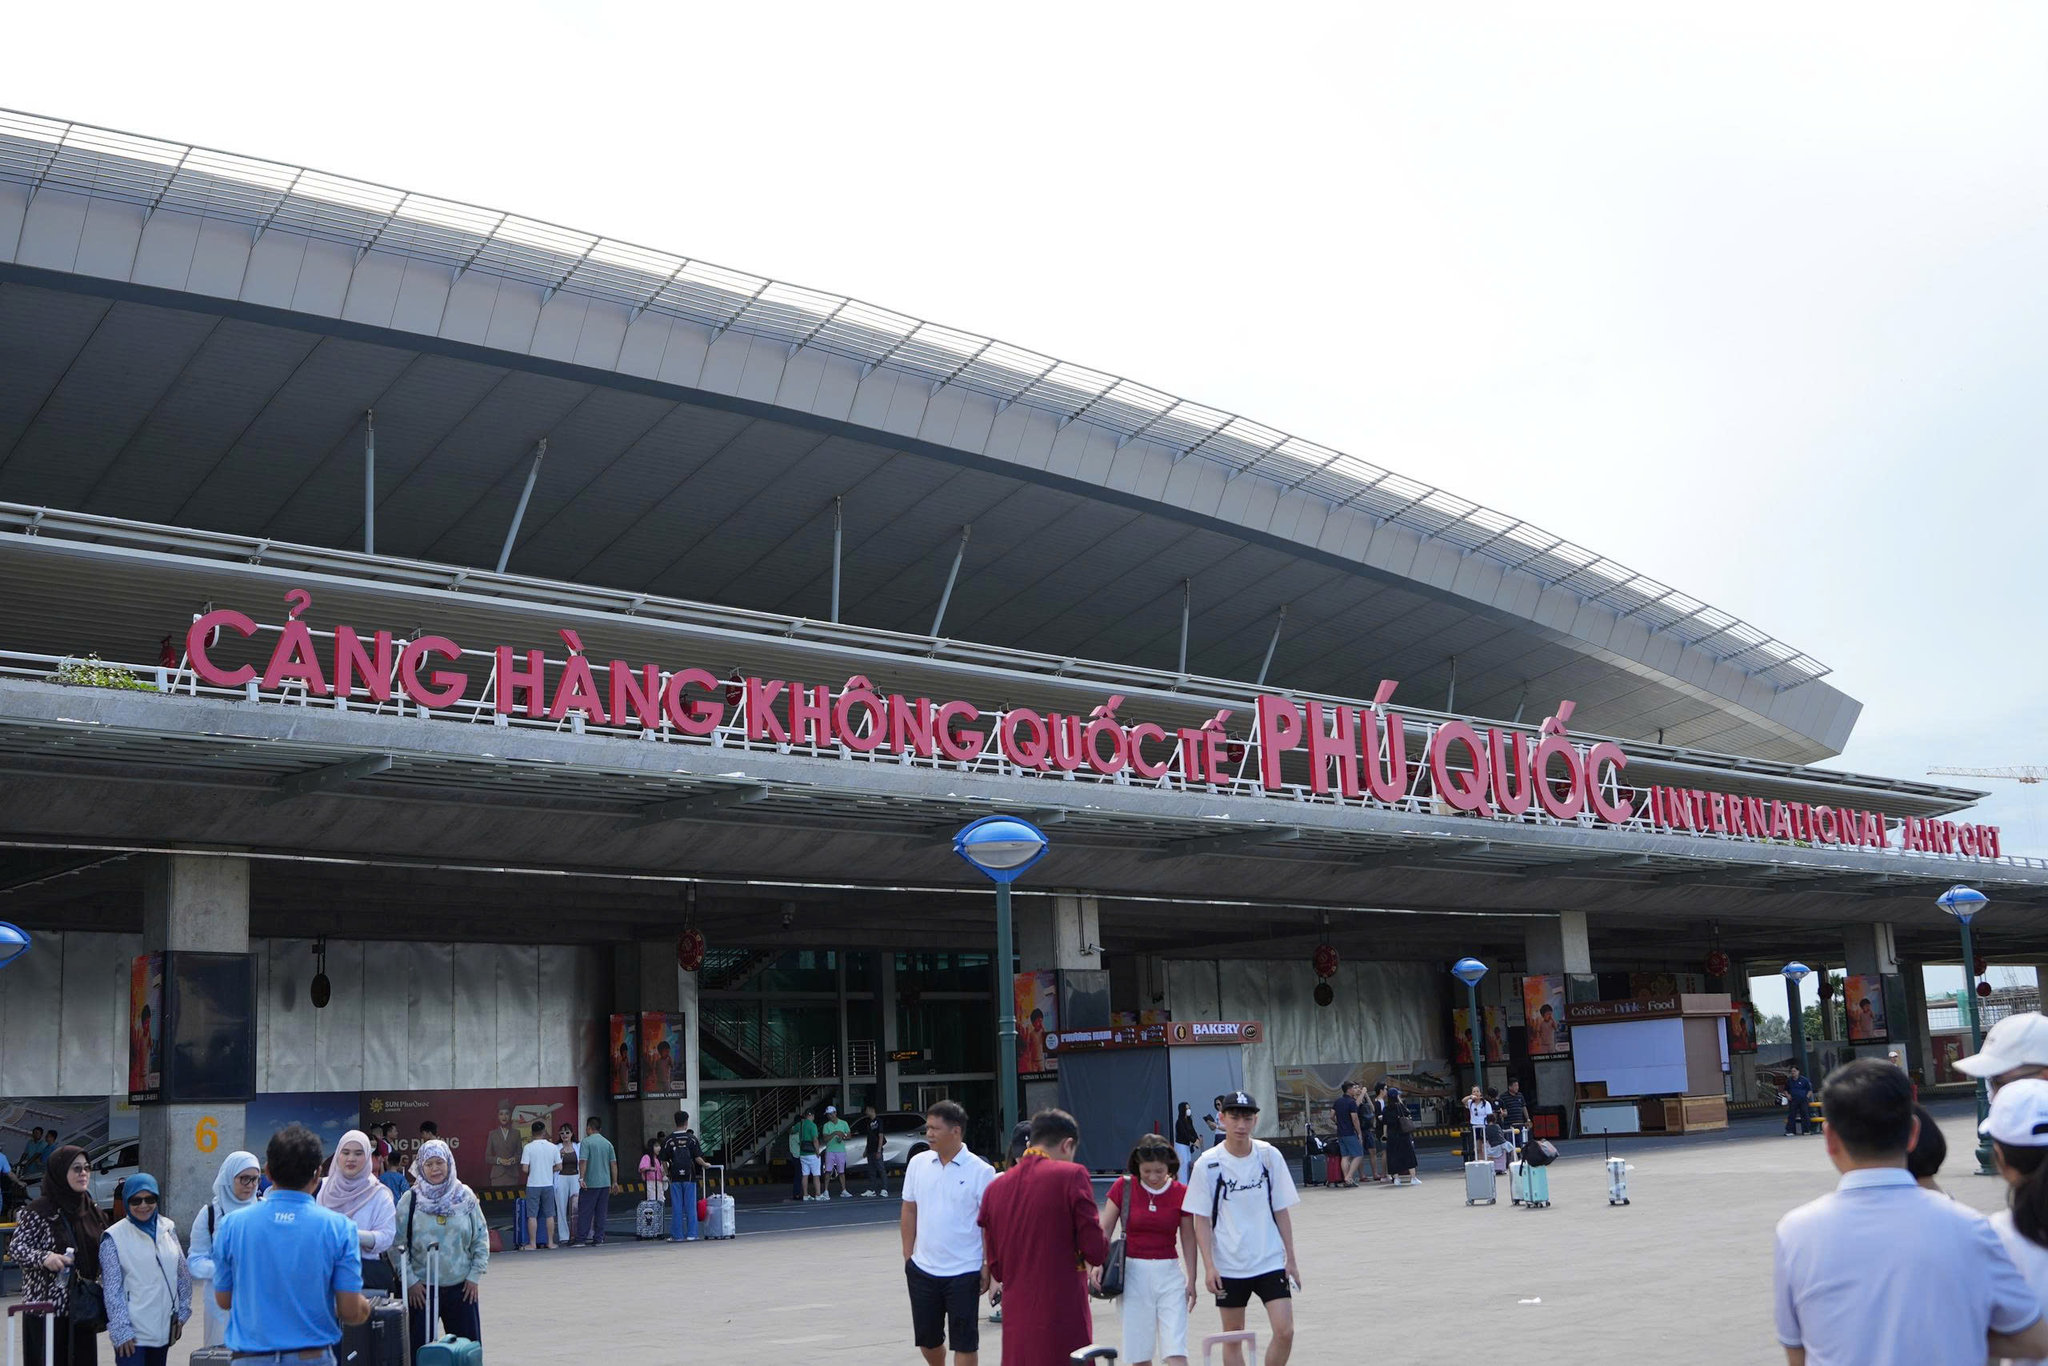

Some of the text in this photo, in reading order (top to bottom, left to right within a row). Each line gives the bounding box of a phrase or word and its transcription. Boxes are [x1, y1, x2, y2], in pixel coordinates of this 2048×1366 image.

[186, 588, 2001, 859] CẢNG HÀNG KHÔNG QUỐC TẾ PHÚ QUỐC INTERNATIONAL AIRPORT
[1571, 998, 1675, 1016] Coffee Drink Food
[1192, 1023, 1240, 1035] BAKERY
[385, 1100, 399, 1108] SUN
[1236, 1092, 1248, 1104] LA
[195, 1116, 219, 1153] 6
